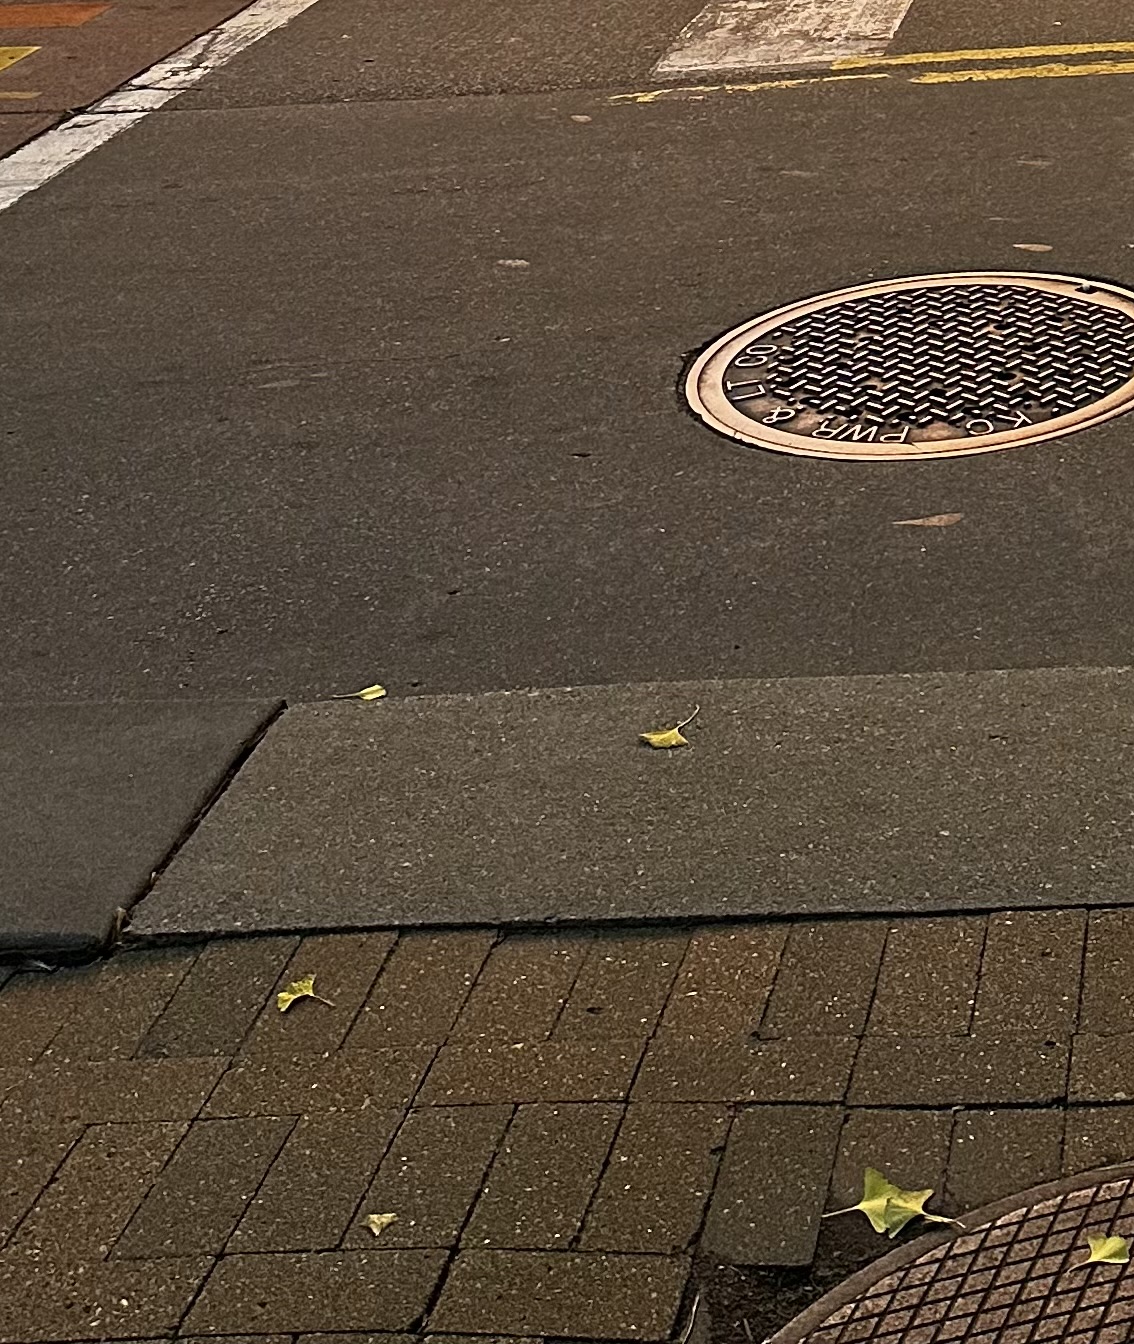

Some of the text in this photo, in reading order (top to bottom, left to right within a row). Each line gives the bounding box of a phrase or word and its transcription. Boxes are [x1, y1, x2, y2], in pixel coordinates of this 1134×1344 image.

[734, 344, 778, 368] CO
[762, 406, 797, 424] &
[811, 420, 910, 443] PWR
